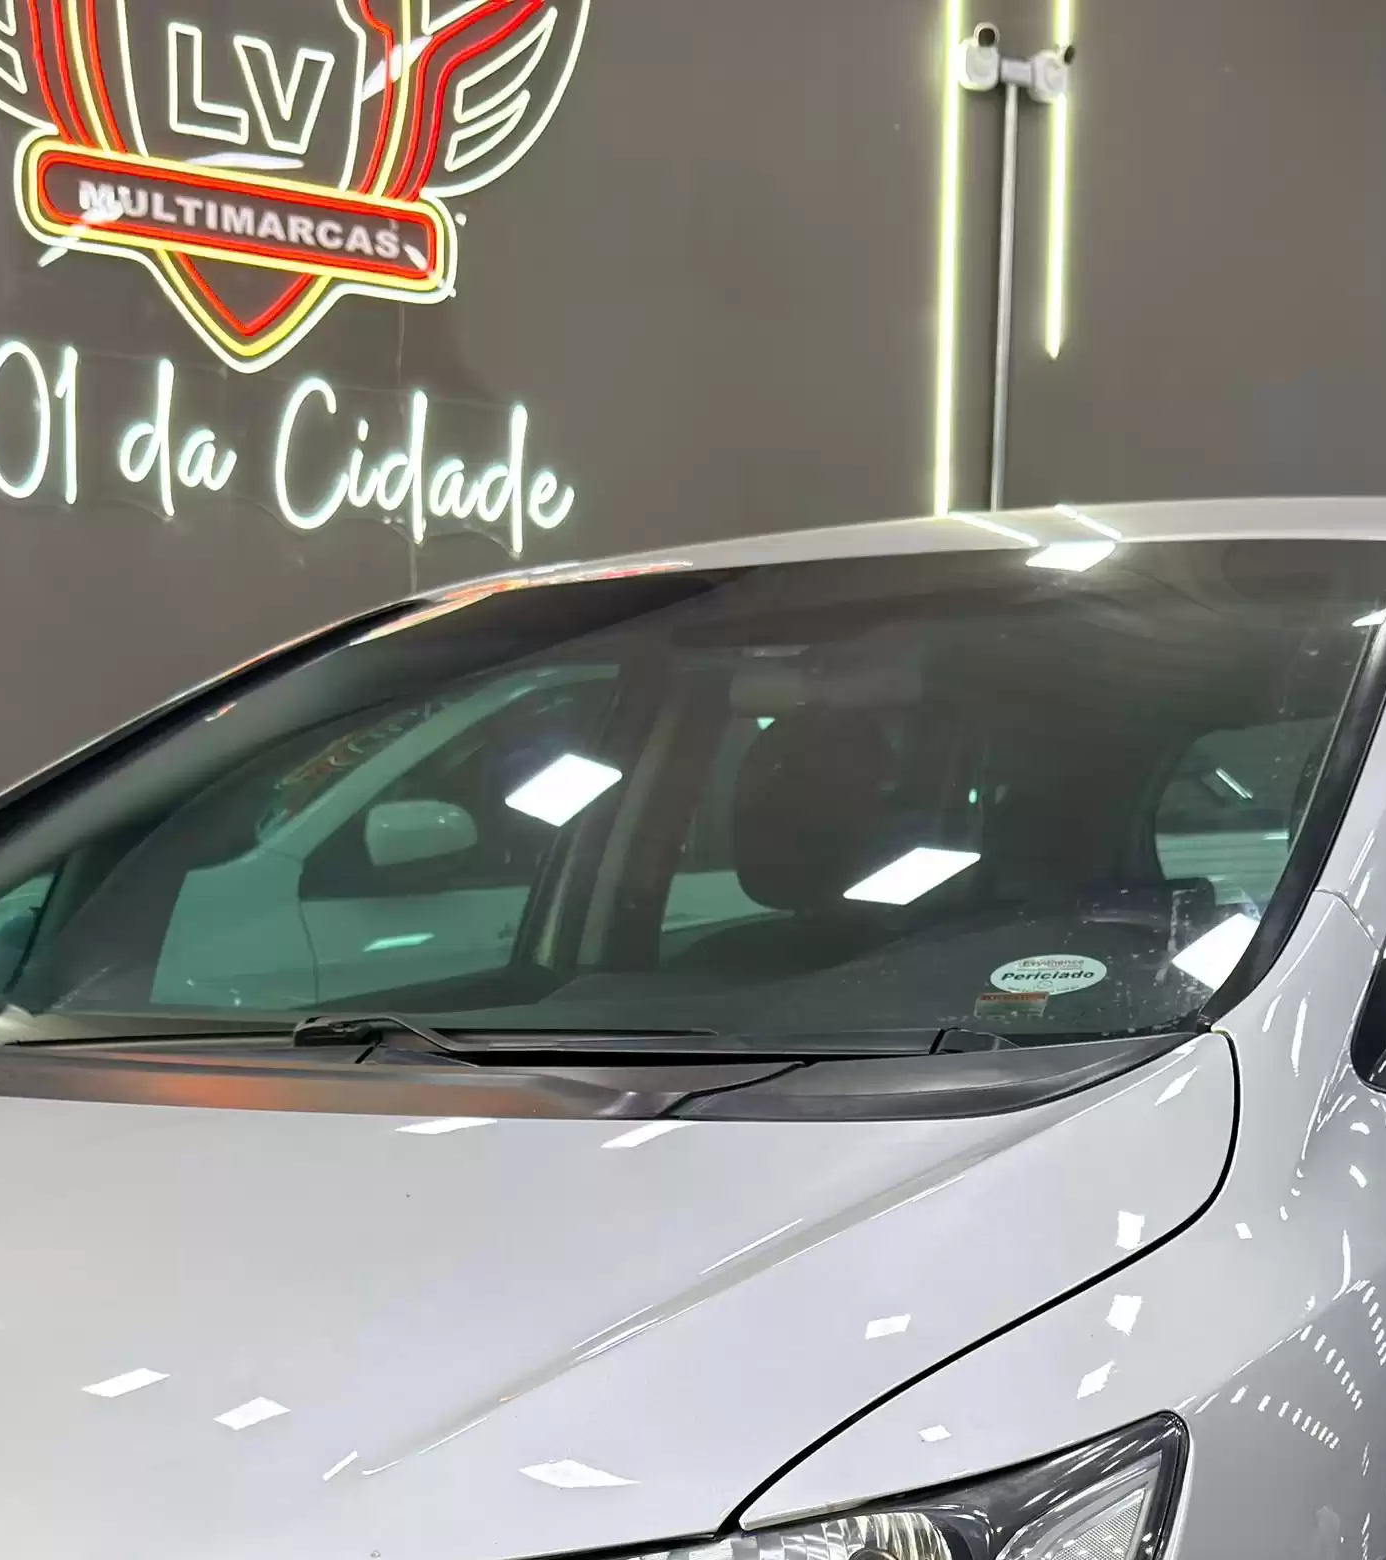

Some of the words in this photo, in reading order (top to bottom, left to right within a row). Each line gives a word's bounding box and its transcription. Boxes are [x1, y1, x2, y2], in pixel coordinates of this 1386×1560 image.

[167, 22, 335, 154] LV
[77, 179, 401, 259] MULTIMARCAS
[118, 358, 238, 517] da
[274, 376, 575, 558] Cidade
[1000, 969, 1096, 982] Periciado
